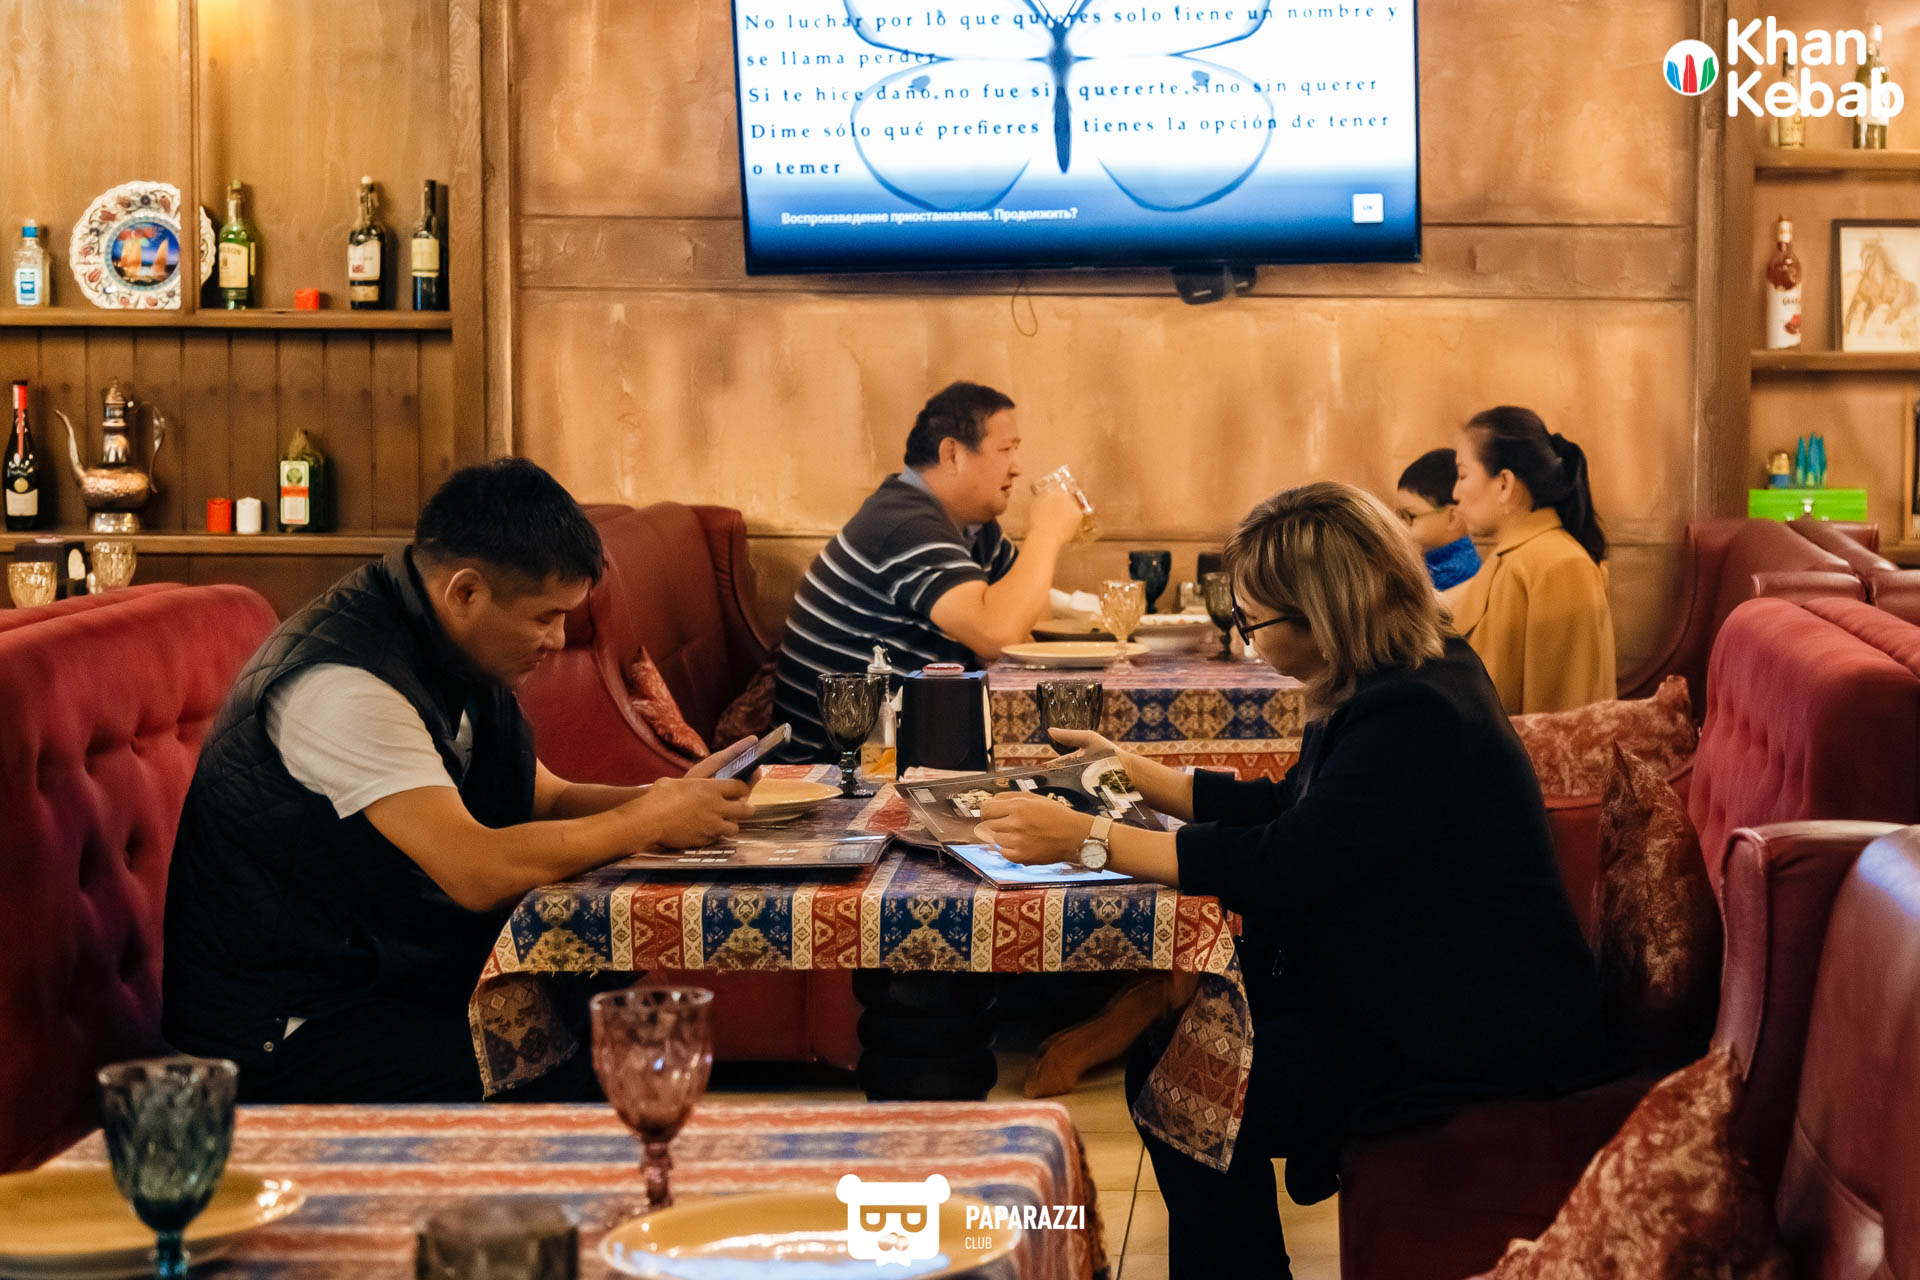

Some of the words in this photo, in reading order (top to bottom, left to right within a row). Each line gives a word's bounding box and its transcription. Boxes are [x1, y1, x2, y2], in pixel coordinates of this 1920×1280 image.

[745, 15, 775, 29] No
[788, 14, 863, 29] luchar
[876, 17, 913, 33] por
[959, 15, 1000, 31] que
[1113, 7, 1161, 22] solo
[1174, 5, 1234, 21] tiene
[1247, 9, 1273, 21] un
[1288, 4, 1375, 18] nombre
[1388, 6, 1398, 21] y
[746, 56, 768, 66] se
[781, 50, 844, 65] llama
[859, 50, 935, 69] perder
[748, 87, 770, 103] Si
[783, 88, 803, 102] te
[816, 86, 864, 101] hice
[983, 83, 1019, 98] fue
[1253, 82, 1287, 93] sin
[1300, 79, 1377, 96] querer
[751, 124, 810, 140] Dime
[823, 121, 871, 138] sólo
[884, 121, 924, 142] qué
[937, 119, 1040, 141] prefieres
[1083, 118, 1154, 133] tienes
[1168, 117, 1186, 131] la
[1200, 114, 1277, 134] opción
[1292, 115, 1315, 129] de
[1329, 115, 1389, 128] tener
[752, 164, 763, 176] o
[775, 160, 842, 176] temer
[781, 211, 889, 227] Воспроизведение
[890, 210, 992, 226] приостановлено.
[993, 207, 1079, 223] Продолжить?
